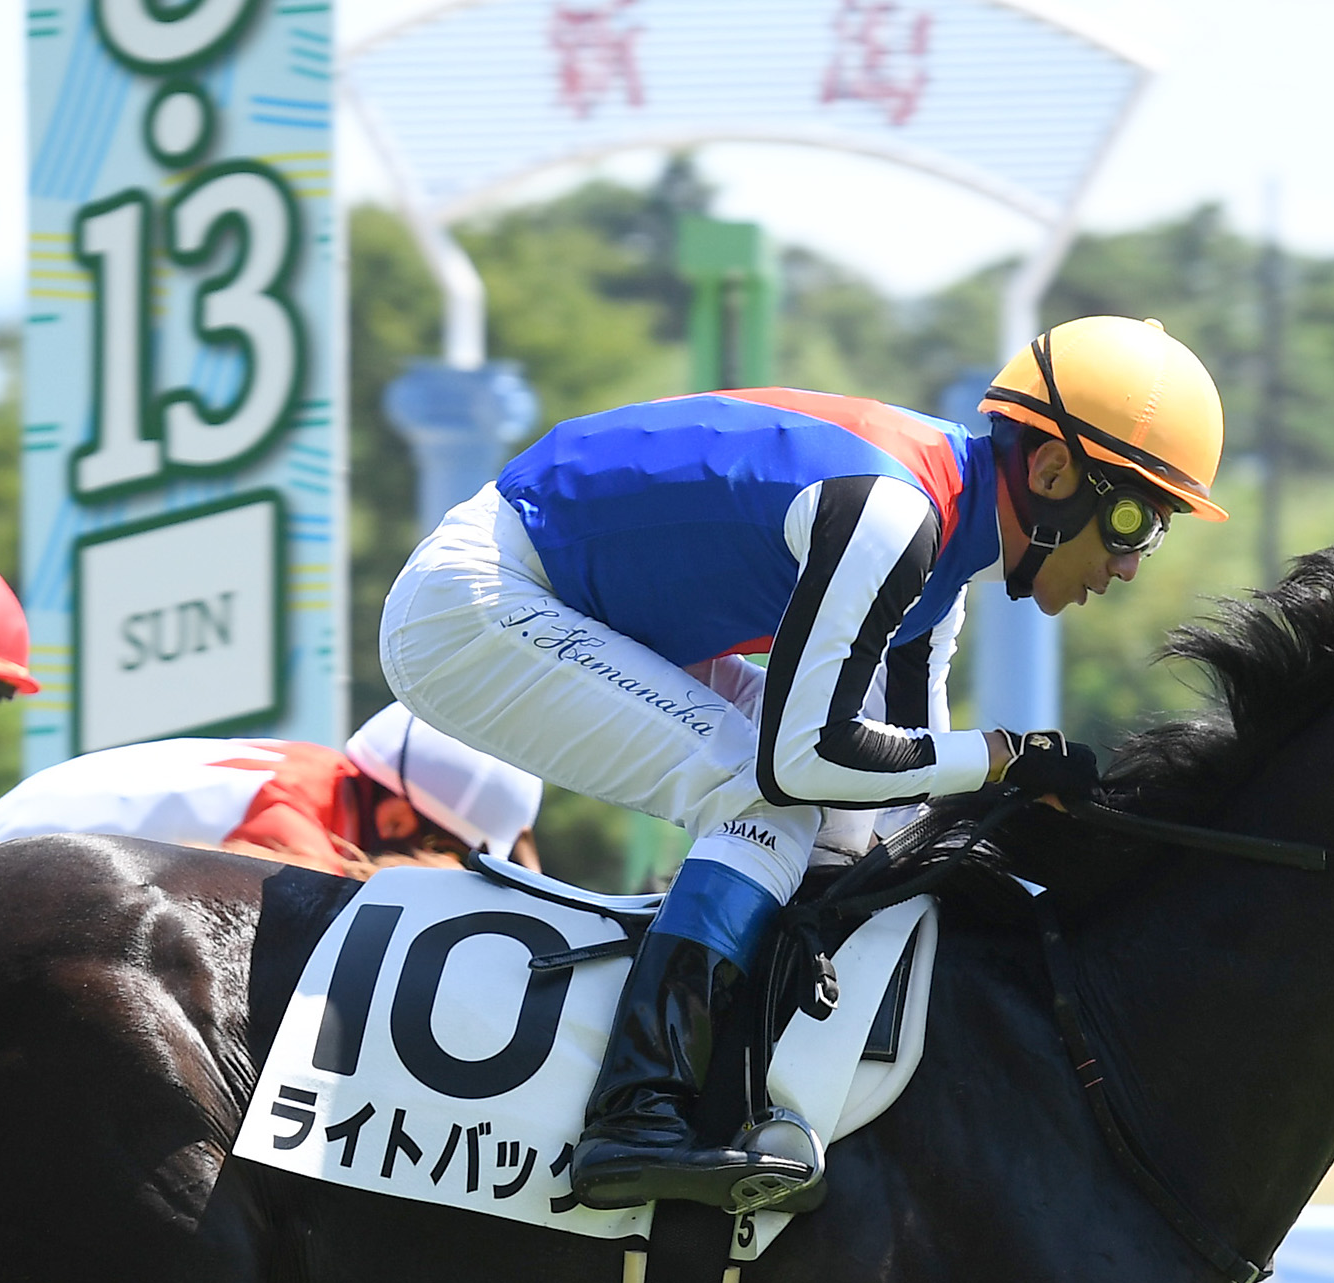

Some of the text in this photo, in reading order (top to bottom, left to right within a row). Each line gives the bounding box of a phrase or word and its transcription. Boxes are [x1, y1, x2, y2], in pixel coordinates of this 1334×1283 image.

[121, 591, 236, 673] SUN
[533, 624, 727, 737] Hamanaka
[312, 903, 574, 1100] 10
